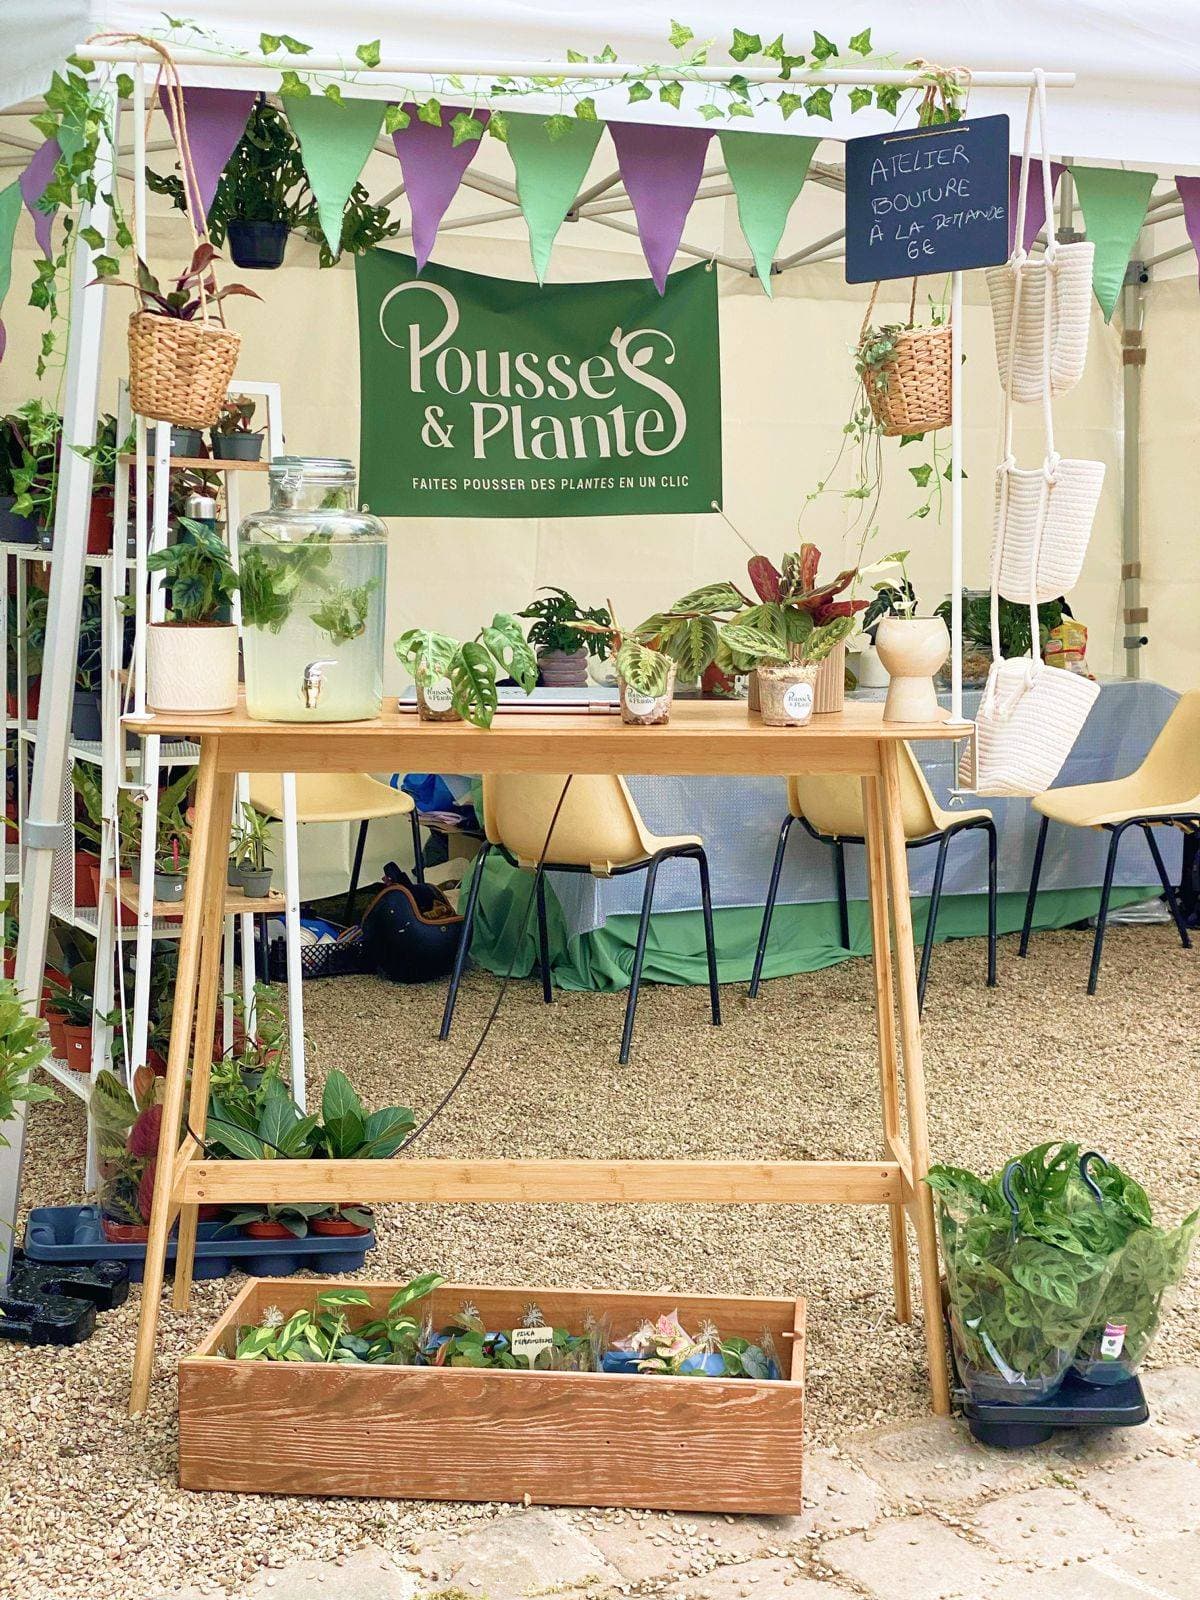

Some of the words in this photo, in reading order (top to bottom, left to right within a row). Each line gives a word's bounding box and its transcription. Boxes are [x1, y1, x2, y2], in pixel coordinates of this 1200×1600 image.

[870, 144, 970, 186] ATELIER
[871, 178, 970, 215] BOUTURE
[869, 219, 884, 246] À
[895, 221, 925, 241] LA
[931, 206, 1005, 231] DEMANDE
[421, 405, 455, 449] &
[412, 477, 458, 490] FAITES
[463, 478, 526, 490] POUSSER
[531, 478, 556, 490] DES
[560, 477, 615, 490] PLANTES
[619, 476, 634, 489] EN
[639, 476, 656, 488] UN
[661, 475, 689, 487] CLIC
